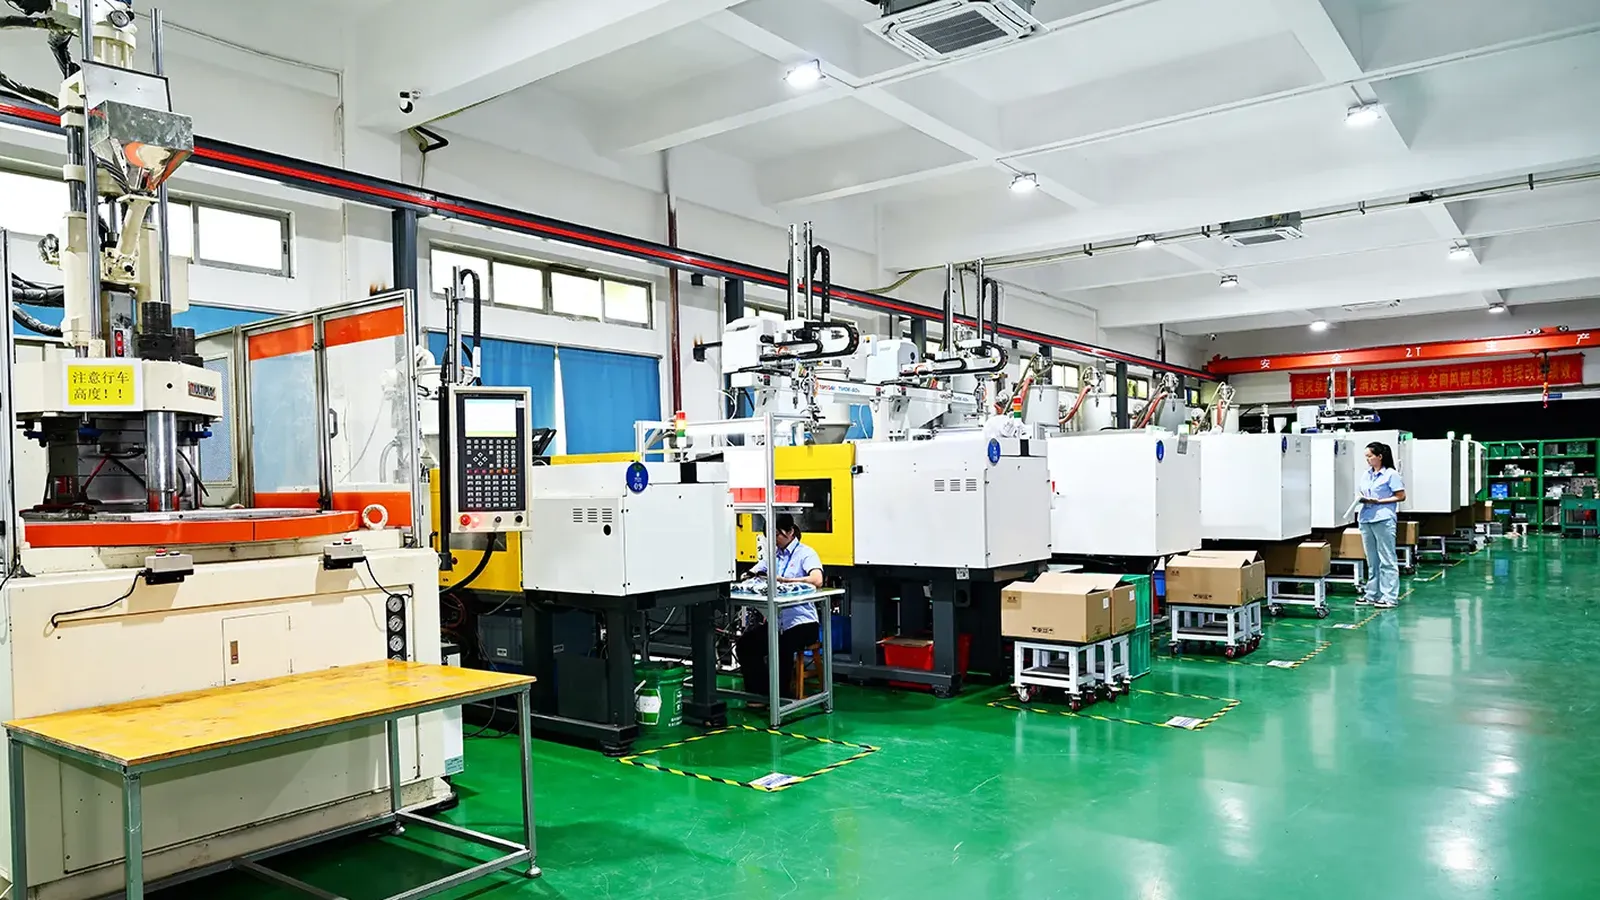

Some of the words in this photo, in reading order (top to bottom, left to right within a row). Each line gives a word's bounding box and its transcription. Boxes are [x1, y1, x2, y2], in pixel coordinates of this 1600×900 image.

[1260, 358, 1270, 369] 安
[1331, 352, 1342, 362] 全
[1406, 346, 1422, 358] 2T
[1576, 333, 1590, 345] 产
[72, 371, 129, 385] 注意行车
[73, 388, 123, 400] 高度！！
[634, 483, 643, 491] 09
